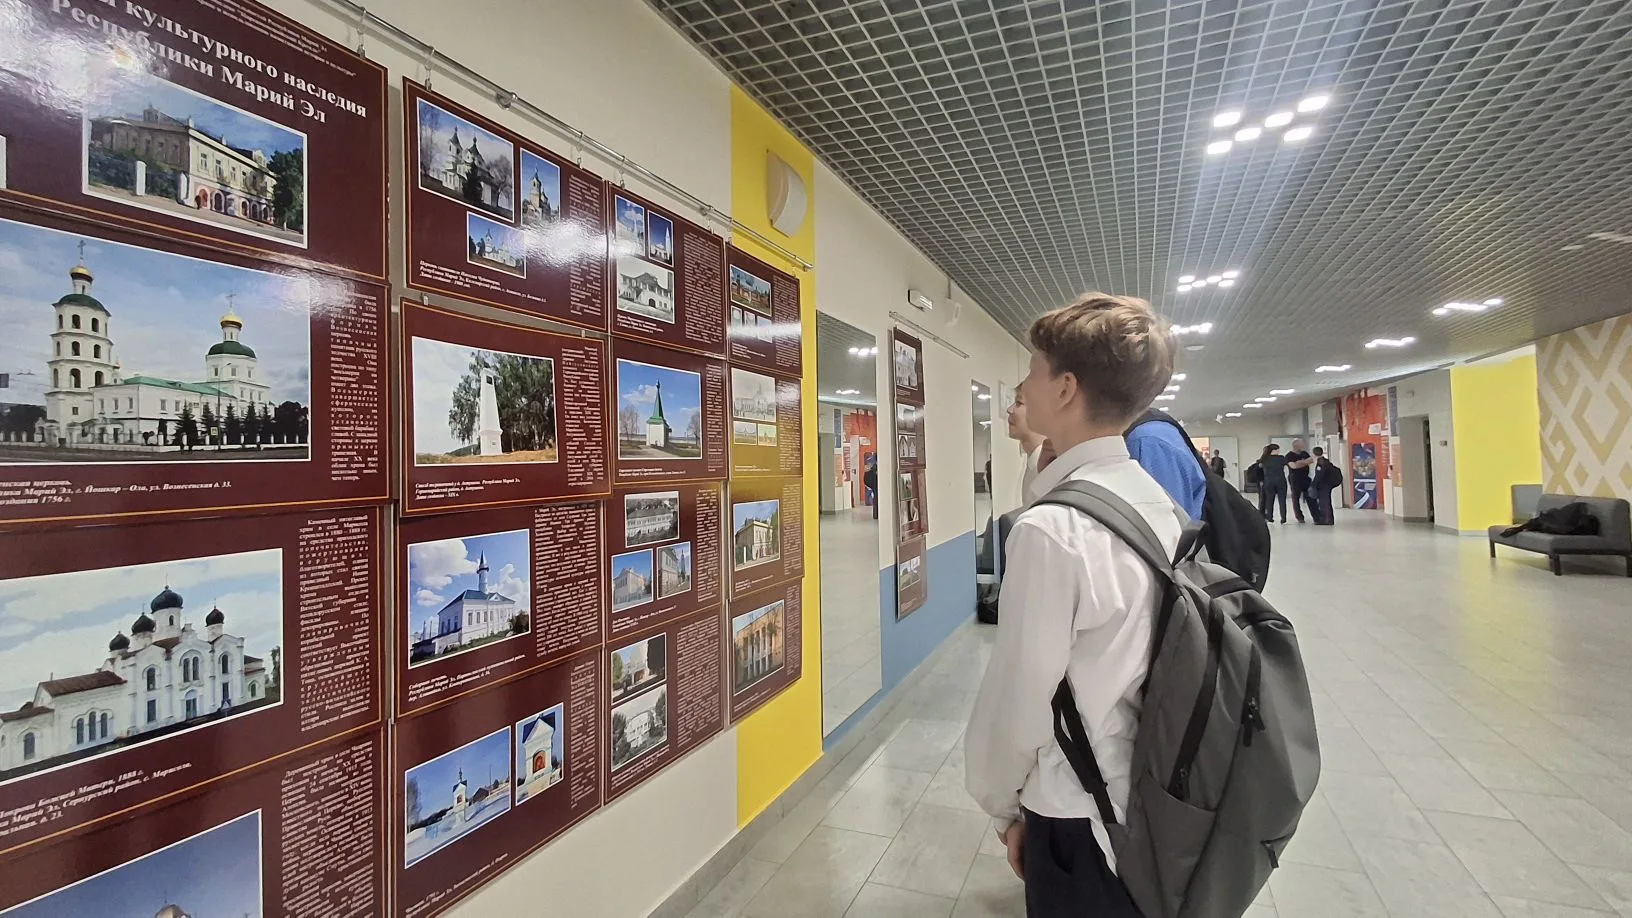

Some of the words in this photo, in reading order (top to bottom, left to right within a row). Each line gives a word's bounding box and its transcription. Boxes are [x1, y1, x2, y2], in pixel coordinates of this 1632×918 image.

[126, 1, 277, 78] культурного
[284, 71, 367, 118] наследия
[221, 65, 294, 110] Марий
[300, 99, 326, 122] Эл
